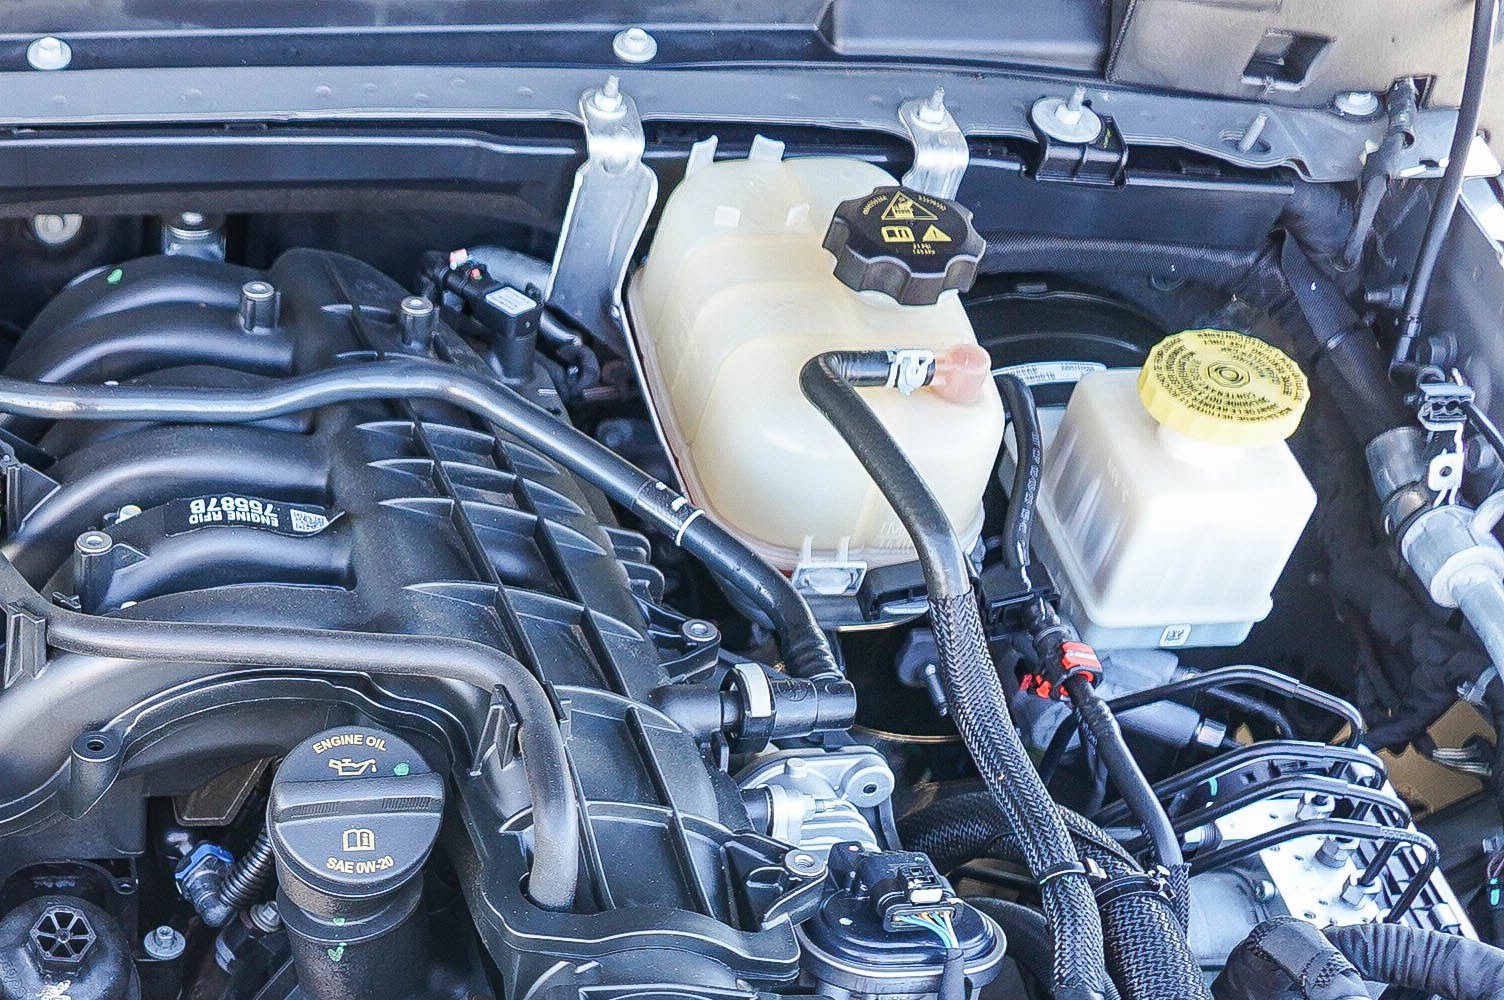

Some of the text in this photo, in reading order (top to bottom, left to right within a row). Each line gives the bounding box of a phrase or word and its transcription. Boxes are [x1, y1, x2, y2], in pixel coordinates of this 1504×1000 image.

[188, 510, 280, 528] ENGINE RFID
[312, 734, 389, 754] ENGINE OIL
[326, 855, 395, 875] SAE 0W-20
